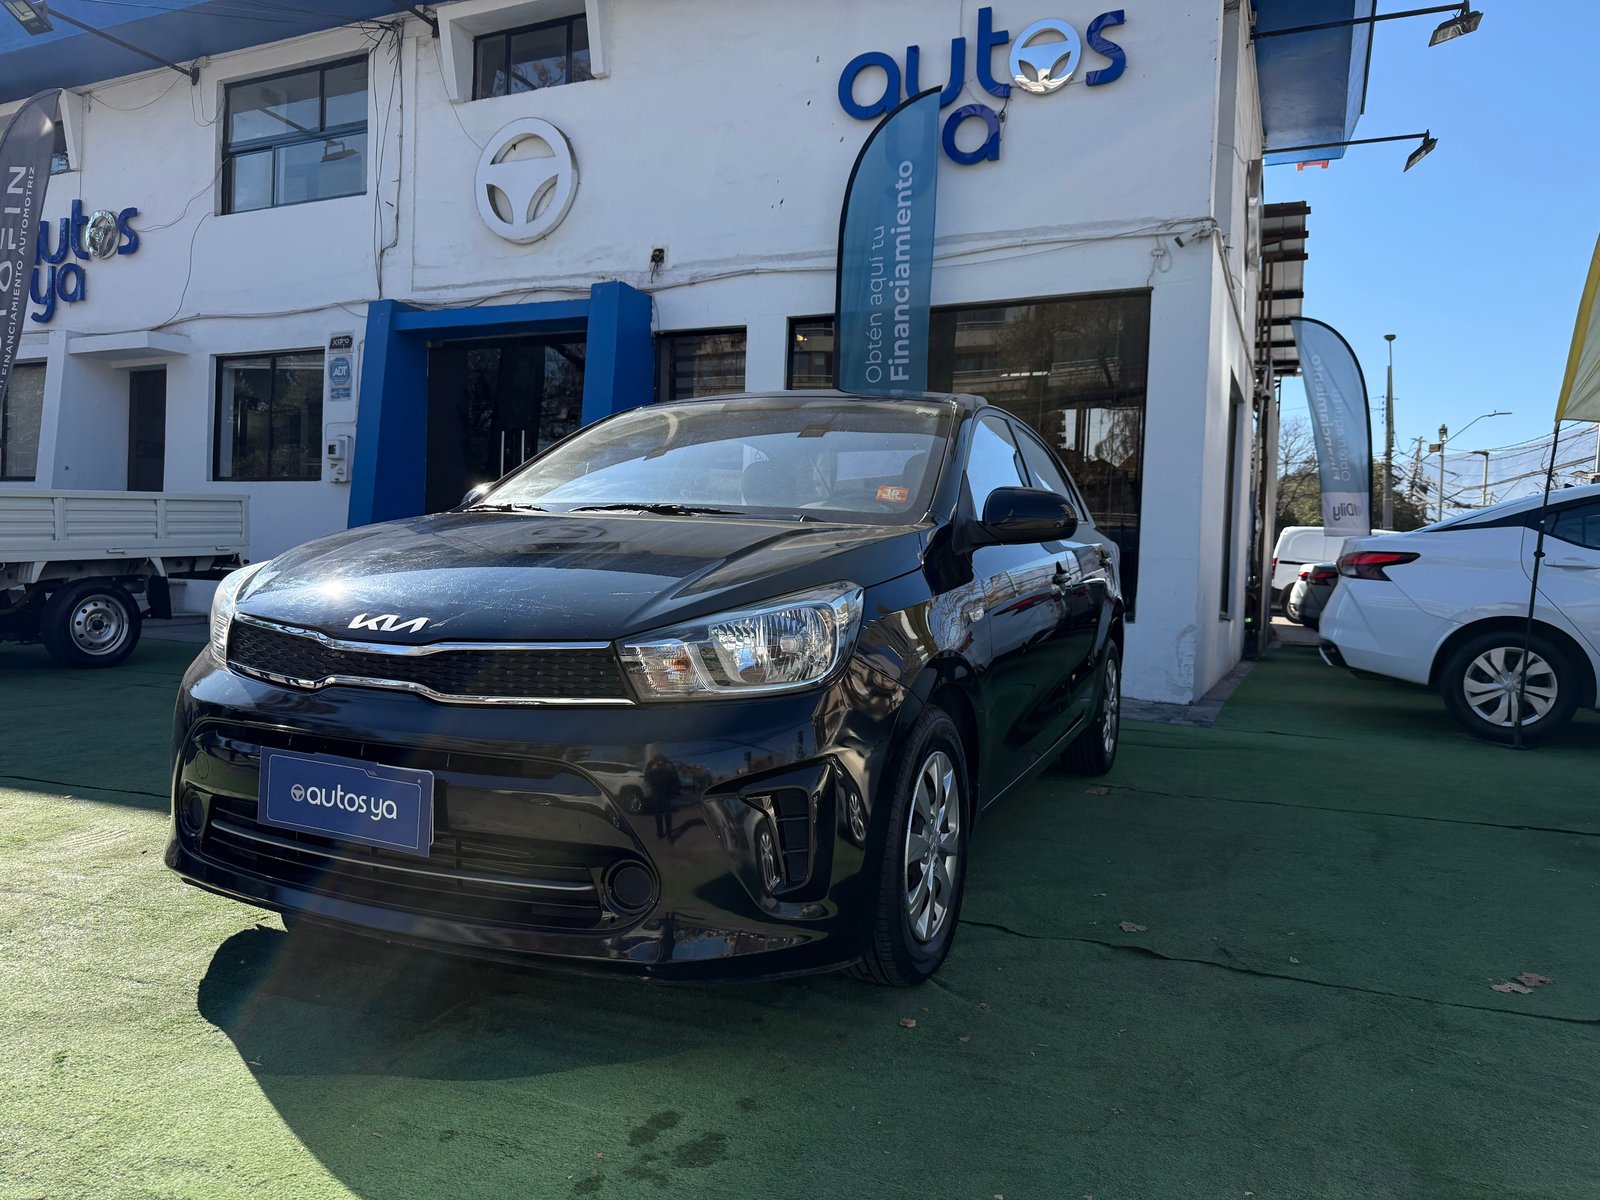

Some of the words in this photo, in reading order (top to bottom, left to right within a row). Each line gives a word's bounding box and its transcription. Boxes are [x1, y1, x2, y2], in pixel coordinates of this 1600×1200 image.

[838, 7, 1127, 121] autos
[35, 199, 140, 266] utos
[872, 225, 885, 249] tu
[2, 260, 24, 376] FINANCIAMIENTO
[20, 166, 35, 256] AUTOMOTRIZ
[29, 263, 86, 323] ya
[870, 256, 887, 305] aquí
[888, 160, 914, 381] Financiamiento
[333, 366, 348, 377] ADT
[866, 312, 883, 383] Obtén
[348, 613, 429, 633] KIA
[306, 784, 367, 813] autos
[370, 797, 397, 821] ya
